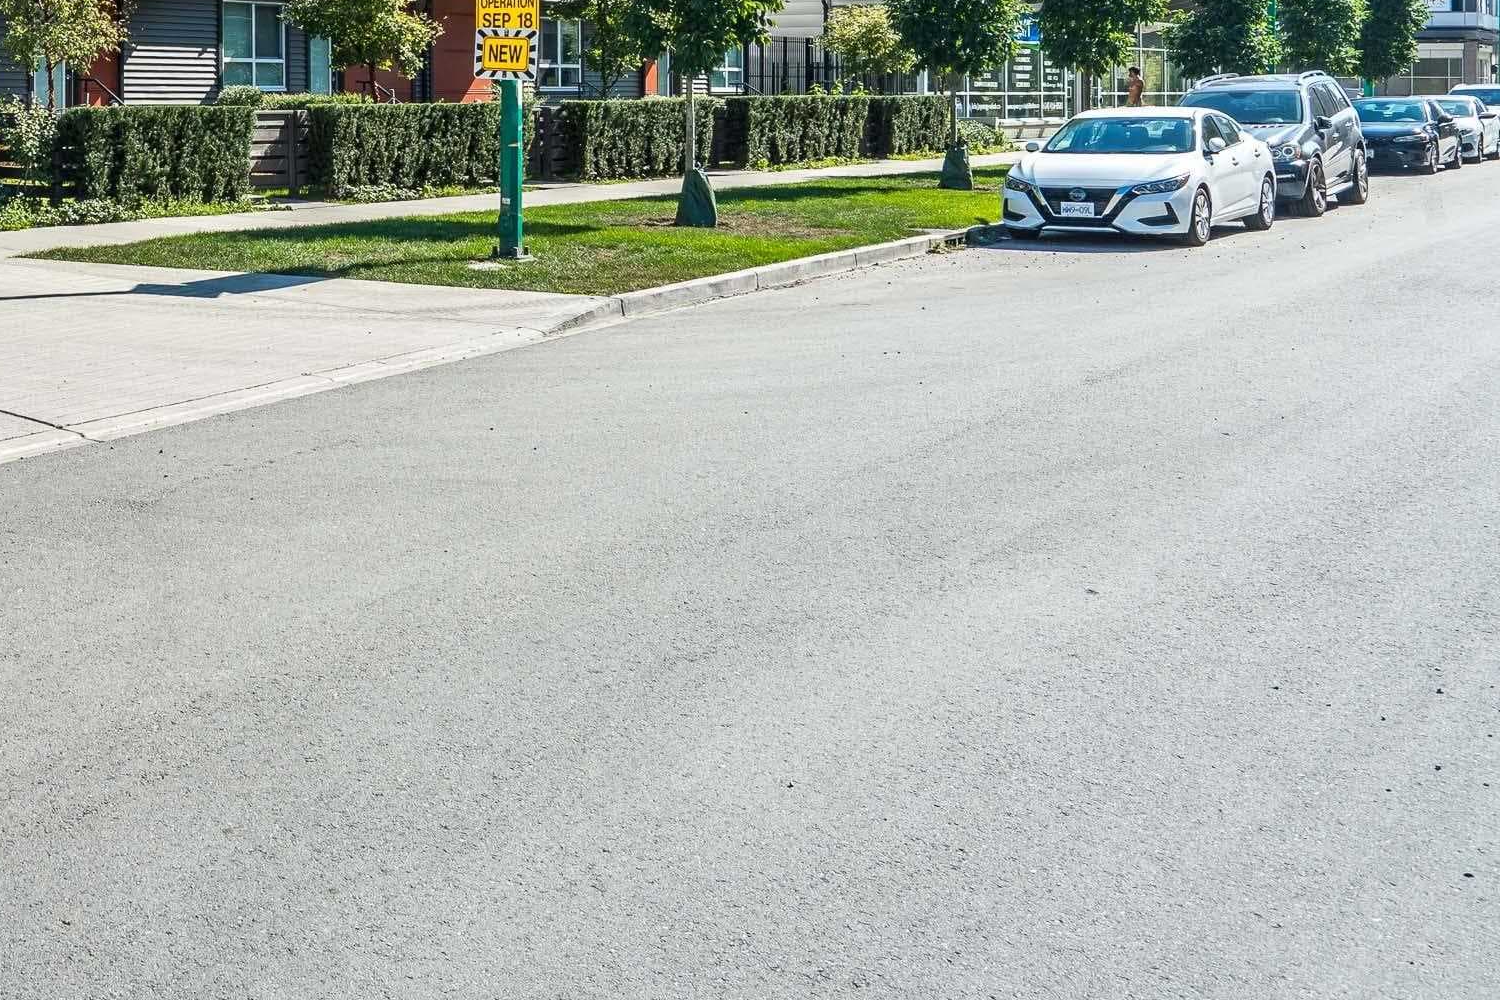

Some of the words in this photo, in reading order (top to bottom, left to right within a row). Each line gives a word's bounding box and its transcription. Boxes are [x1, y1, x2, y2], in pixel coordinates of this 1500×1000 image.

[482, 12, 511, 28] SEP
[517, 12, 533, 28] 18
[488, 44, 523, 63] NEW
